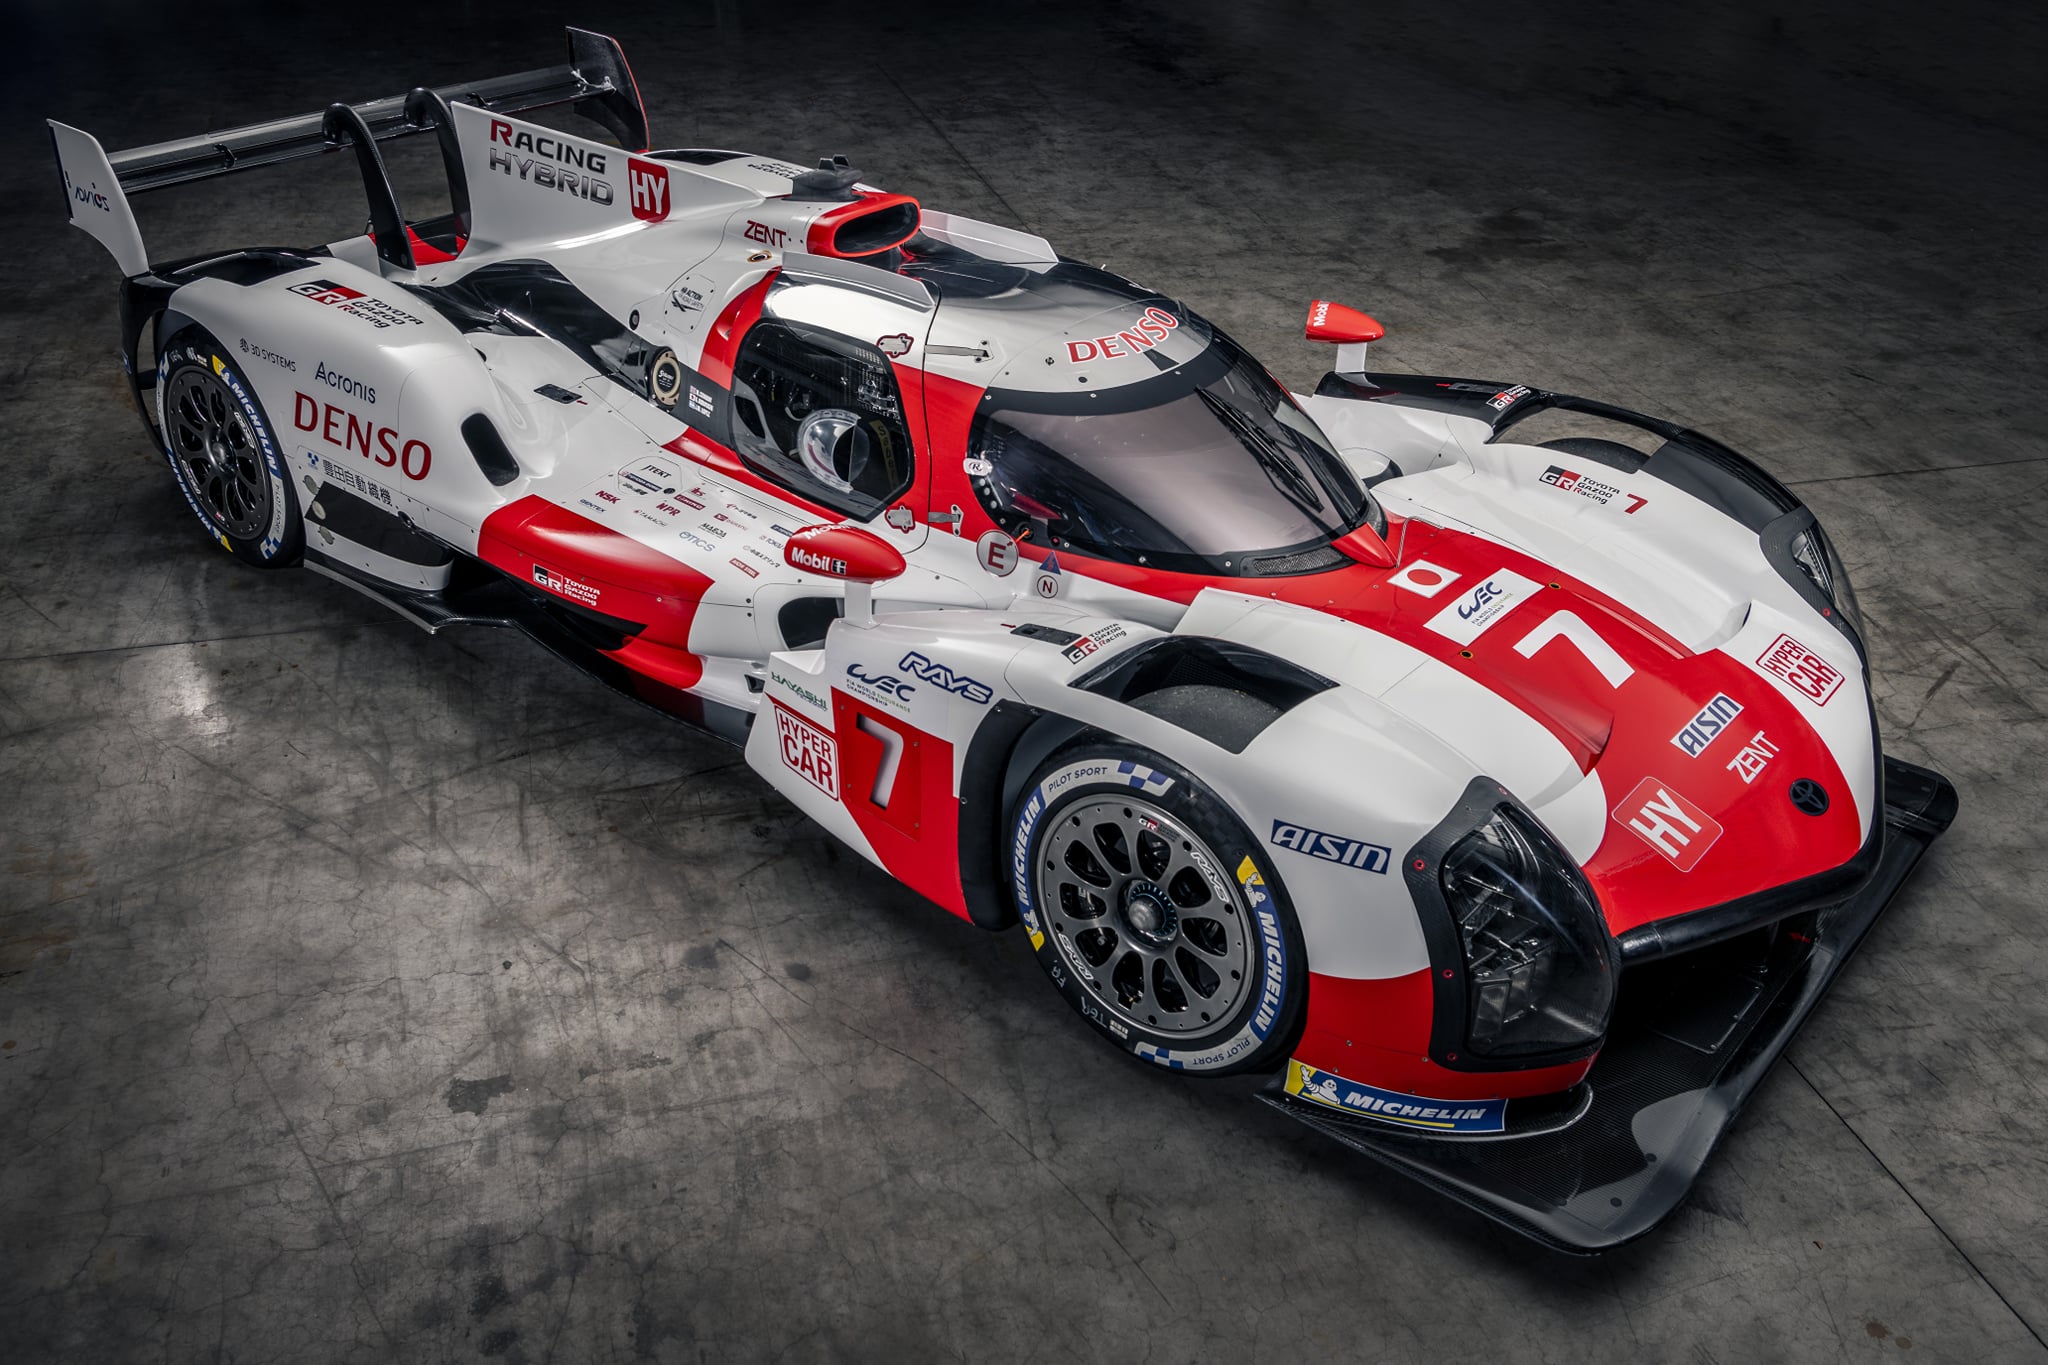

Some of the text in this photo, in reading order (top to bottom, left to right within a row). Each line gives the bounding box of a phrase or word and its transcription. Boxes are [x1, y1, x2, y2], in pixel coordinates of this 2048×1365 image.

[490, 119, 607, 174] RACING
[490, 148, 613, 206] HYBRID
[631, 169, 666, 215] HY
[744, 219, 787, 248] ZENT
[289, 283, 349, 305] GR
[337, 303, 390, 329] Racing
[352, 301, 406, 326] GAZOO
[367, 297, 425, 326] TOYOTA
[1065, 306, 1179, 363] DENSO
[250, 343, 297, 372] 3D SYSTEMS
[314, 361, 376, 404] Acronis
[231, 382, 278, 471] MICHELIN
[294, 390, 432, 481] DENSO
[641, 464, 672, 479] JTEKT
[1540, 471, 1577, 492] GR
[1583, 476, 1620, 495] TOYOTA
[595, 490, 622, 505] NSK
[1573, 486, 1608, 505] Racing
[1577, 482, 1613, 499] GAZOO
[1624, 493, 1649, 514] 7
[655, 502, 681, 517] NPR
[679, 531, 716, 552] OTICS
[987, 541, 1007, 570] E
[791, 547, 830, 571] Mobil
[534, 572, 562, 592] GR
[564, 577, 601, 596] TOYOTA
[564, 584, 598, 600] GAZOO
[1042, 579, 1053, 594] N
[564, 589, 597, 606] Racing
[1458, 581, 1503, 620] WEC
[1089, 623, 1119, 638] TOYOTA
[1094, 626, 1122, 642] GAZOO
[1098, 630, 1127, 647] Racing
[1066, 638, 1099, 664] GR
[1513, 610, 1635, 689] 7
[1764, 639, 1806, 677] HYPER
[846, 663, 916, 703] WEC
[898, 651, 994, 705] RAYS
[1788, 654, 1837, 698] CAR
[780, 713, 832, 762] HYPER
[1678, 695, 1741, 756] AISIN
[783, 733, 834, 794] CAR
[856, 711, 905, 812] 7
[1726, 730, 1781, 785] ZENT
[1048, 766, 1108, 793] PILOT SPORT
[1629, 788, 1702, 859] HY
[1014, 795, 1042, 906] MICHELIN
[1273, 824, 1389, 872] AISIN
[1191, 851, 1229, 903] RAYS
[1255, 911, 1284, 1032] MICHELIN
[1192, 1036, 1251, 1066] PILOT SPORT
[1344, 1091, 1487, 1121] MICHELIN
